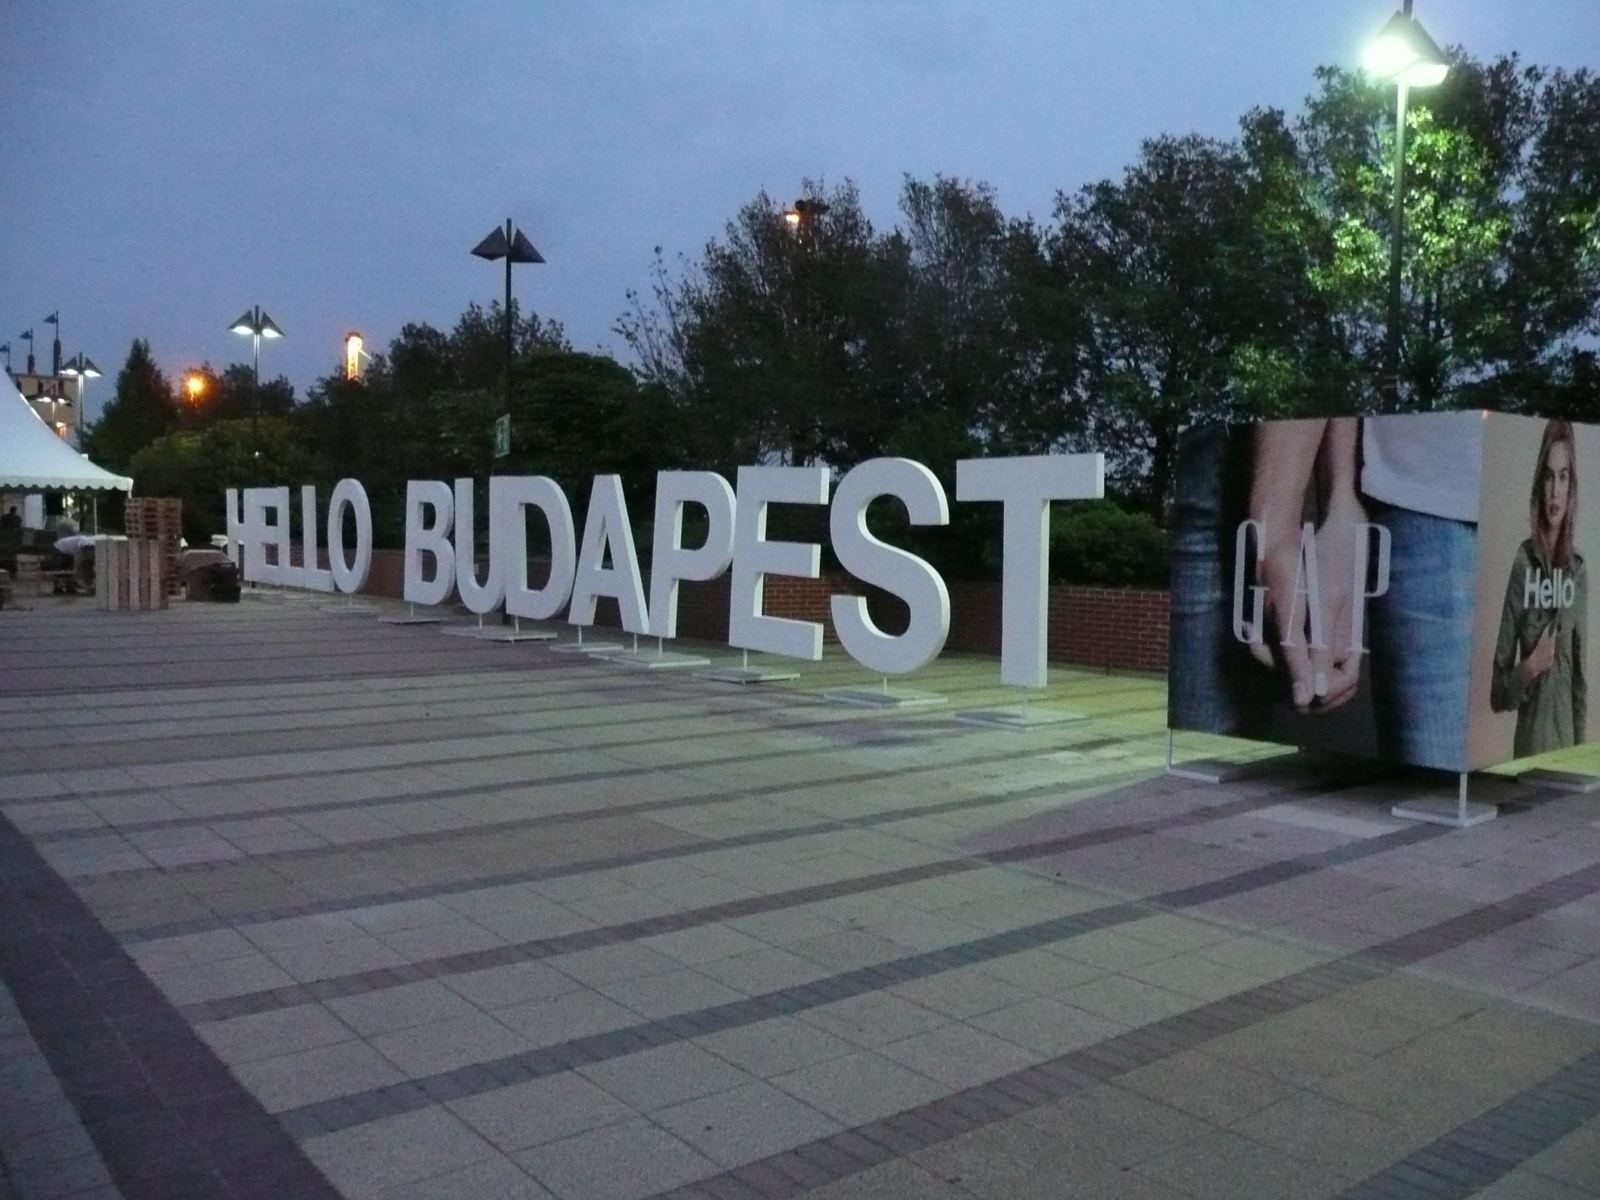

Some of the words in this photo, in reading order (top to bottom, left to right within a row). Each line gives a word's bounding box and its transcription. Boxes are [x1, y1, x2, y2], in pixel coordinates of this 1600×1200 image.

[226, 478, 373, 594] HELLO
[403, 453, 1105, 688] BUDAPEST
[1233, 518, 1391, 654] GAP
[1523, 567, 1575, 610] Hello
